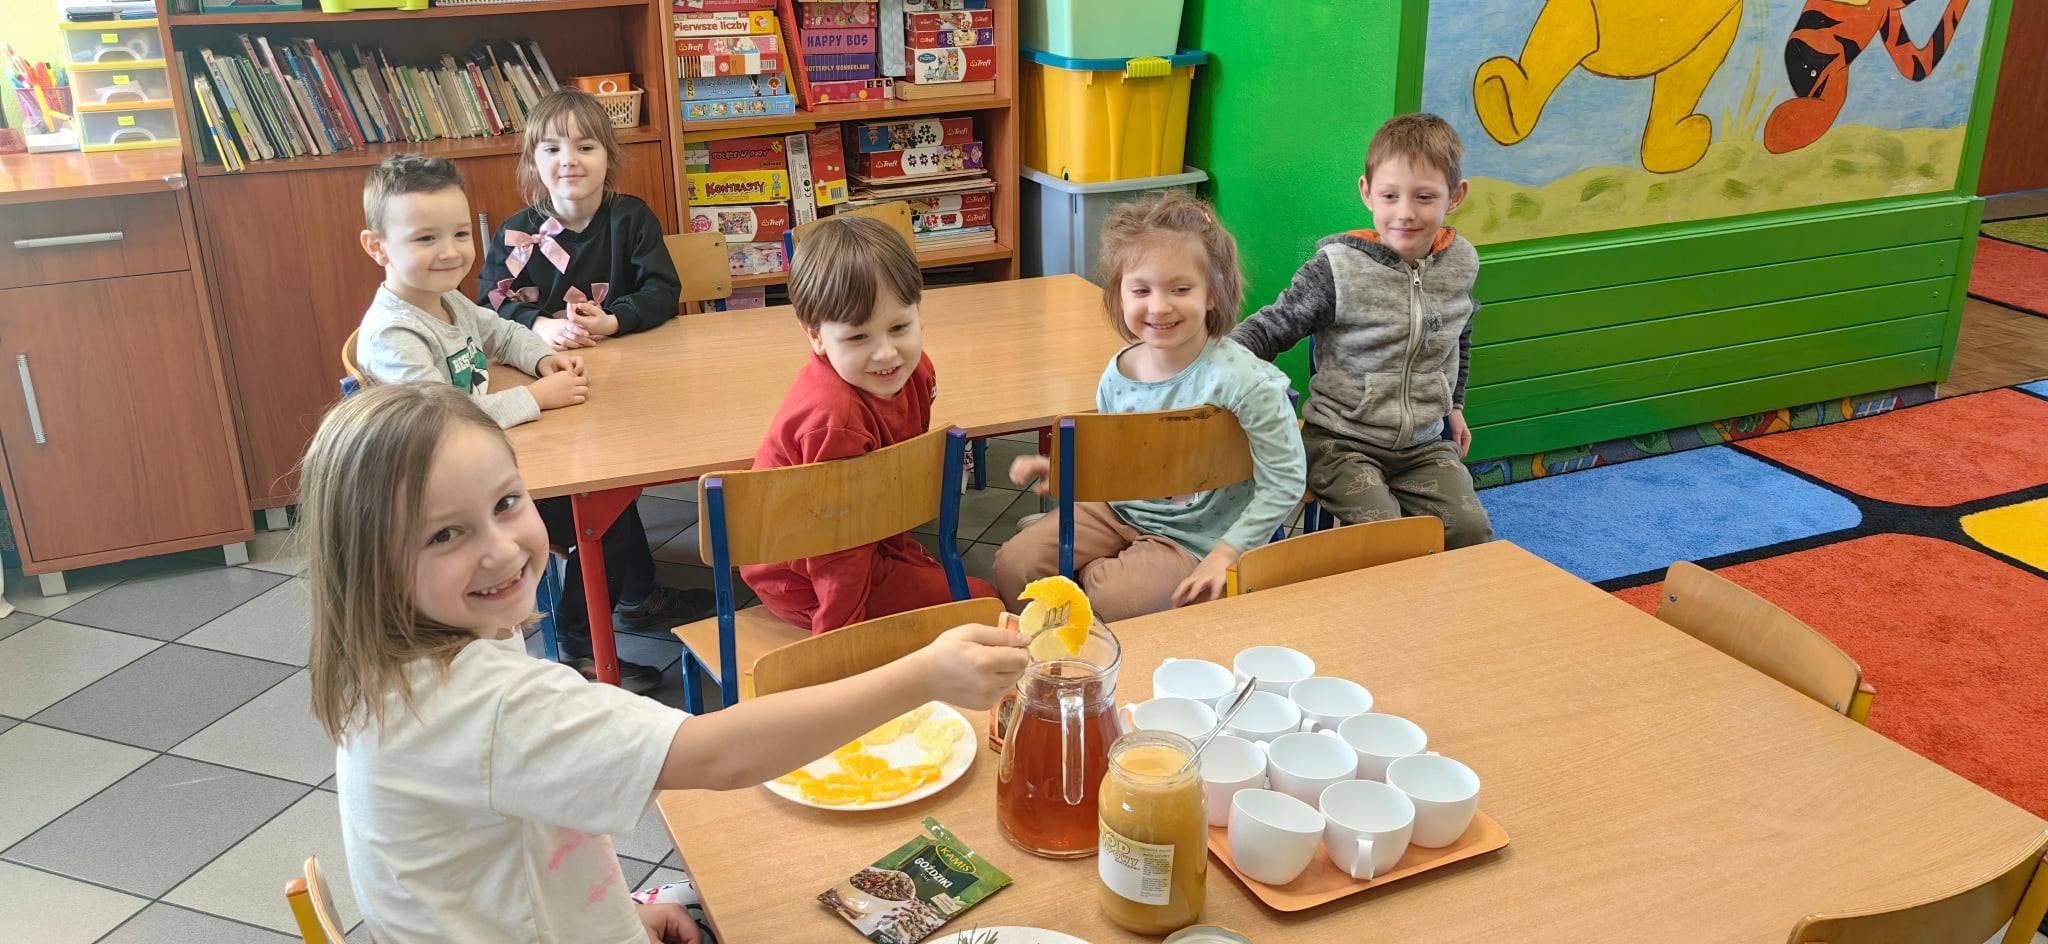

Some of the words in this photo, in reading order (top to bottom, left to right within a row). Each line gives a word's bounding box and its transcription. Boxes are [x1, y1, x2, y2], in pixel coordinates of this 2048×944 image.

[674, 22, 718, 31] Pierwsze
[720, 21, 748, 31] liczby
[807, 35, 842, 47] HAPPY
[847, 34, 868, 46] BUS
[705, 181, 765, 198] KONTRASTY
[940, 846, 972, 872] KAMIS
[914, 857, 953, 888] GOŹDZIKI
